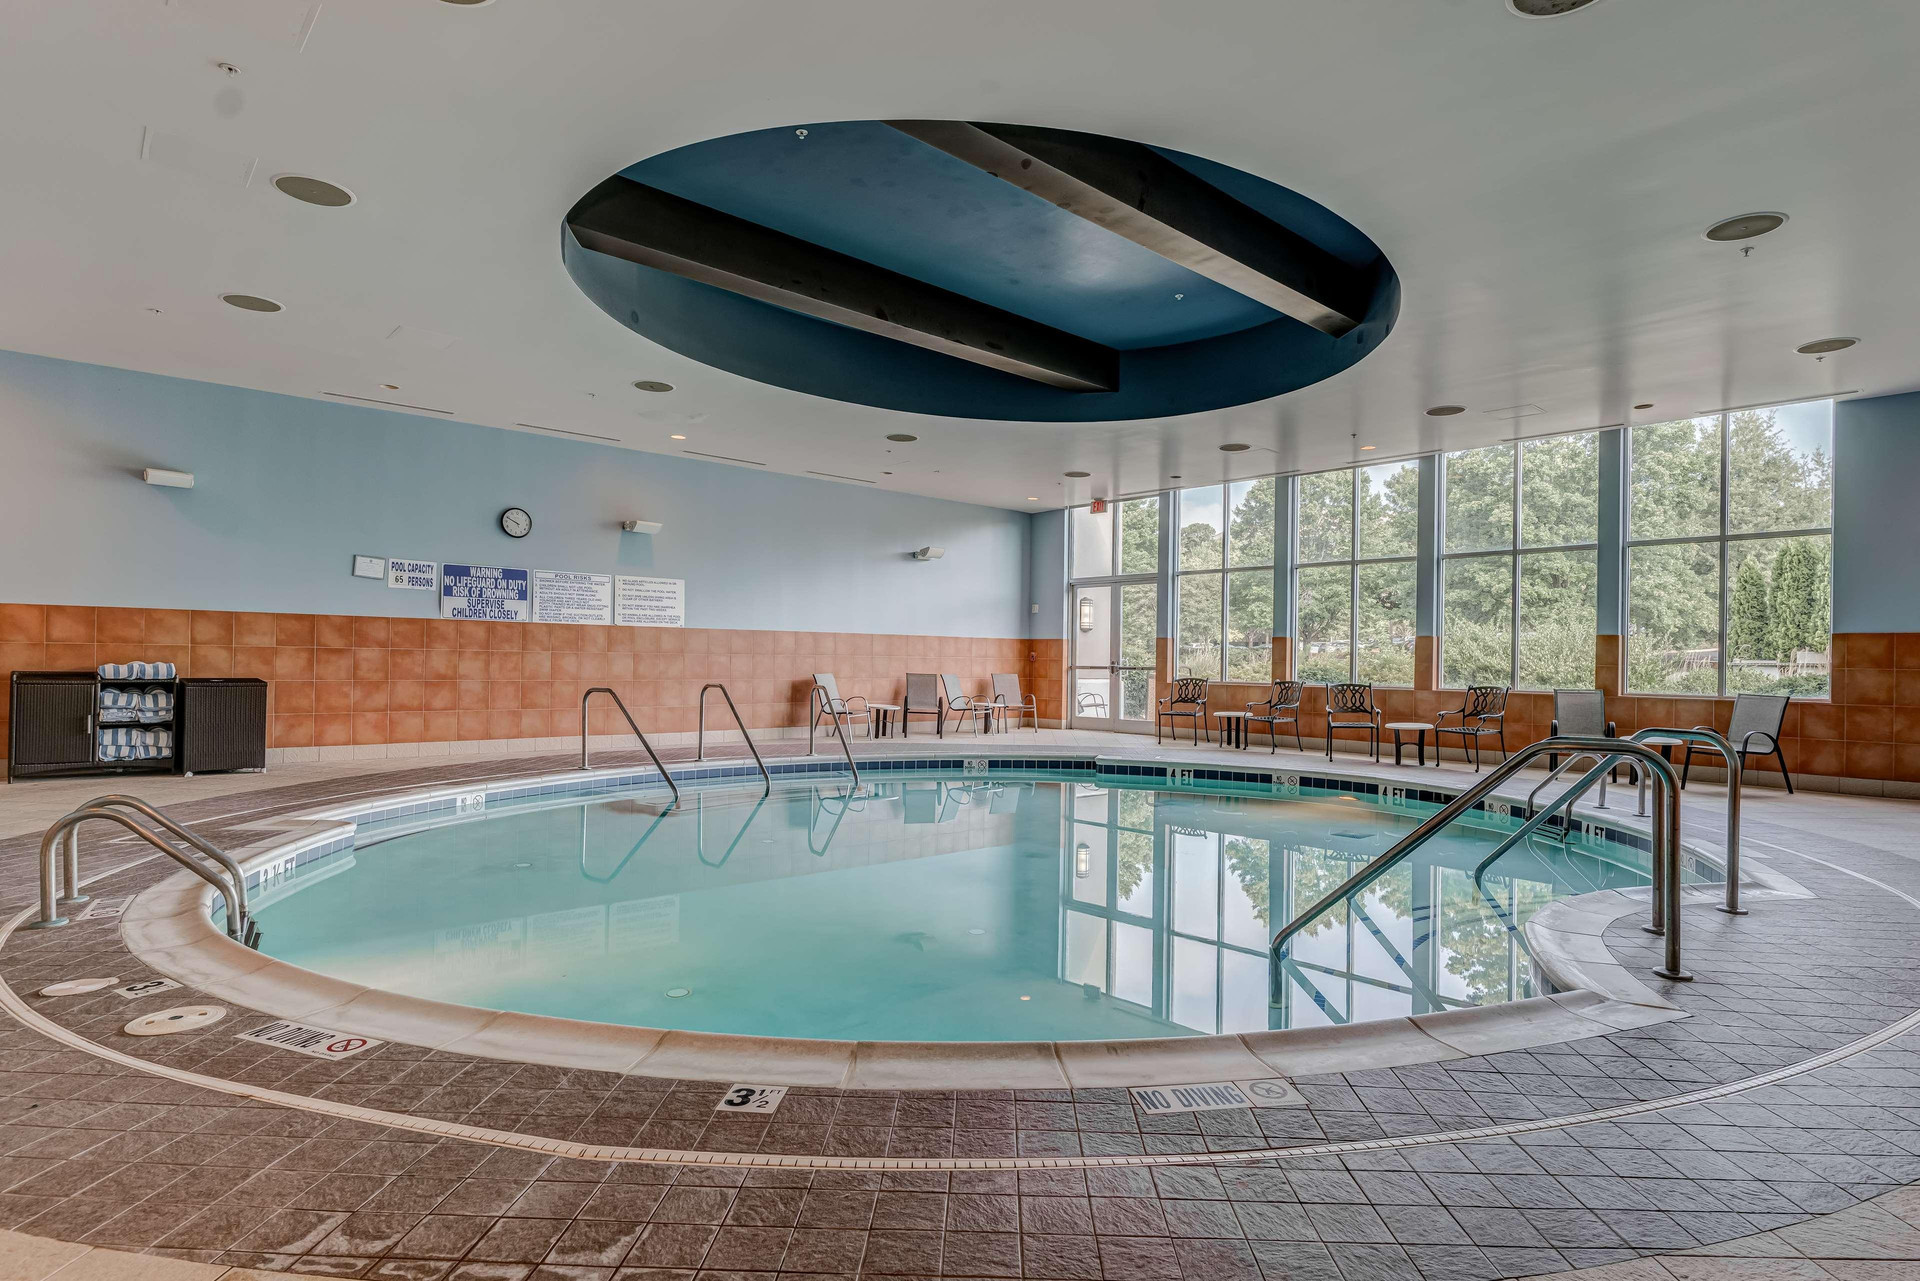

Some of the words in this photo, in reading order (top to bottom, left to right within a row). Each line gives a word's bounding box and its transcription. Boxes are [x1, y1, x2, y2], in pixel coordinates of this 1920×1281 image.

[1092, 501, 1104, 512] EXIT
[391, 562, 406, 572] POOL
[408, 563, 434, 574] CAPACITY
[470, 567, 502, 578] WARNING
[408, 576, 434, 588] PERSONS
[444, 576, 454, 586] NO
[456, 576, 496, 588] LIFEGUARD
[497, 579, 507, 589] ON
[508, 580, 526, 590] DUTY
[452, 586, 469, 596] RISK
[471, 587, 480, 597] OF
[482, 588, 518, 600] DROWNING
[467, 598, 505, 610] SUPERVISE
[452, 608, 487, 619] CHILDREN
[489, 610, 518, 620] CLOSELY
[1170, 768, 1176, 778] 4
[1181, 770, 1192, 780] FT
[1382, 786, 1388, 796] 4
[1392, 787, 1404, 798] FT
[1585, 824, 1590, 836] 4
[1594, 826, 1604, 838] FT
[285, 857, 295, 873] FT
[126, 981, 164, 991] 3
[244, 1022, 290, 1037] NO
[266, 1027, 336, 1048] DIVING
[724, 1088, 756, 1106] 3
[1136, 1090, 1172, 1110] NO
[1170, 1085, 1246, 1108] DIVING
